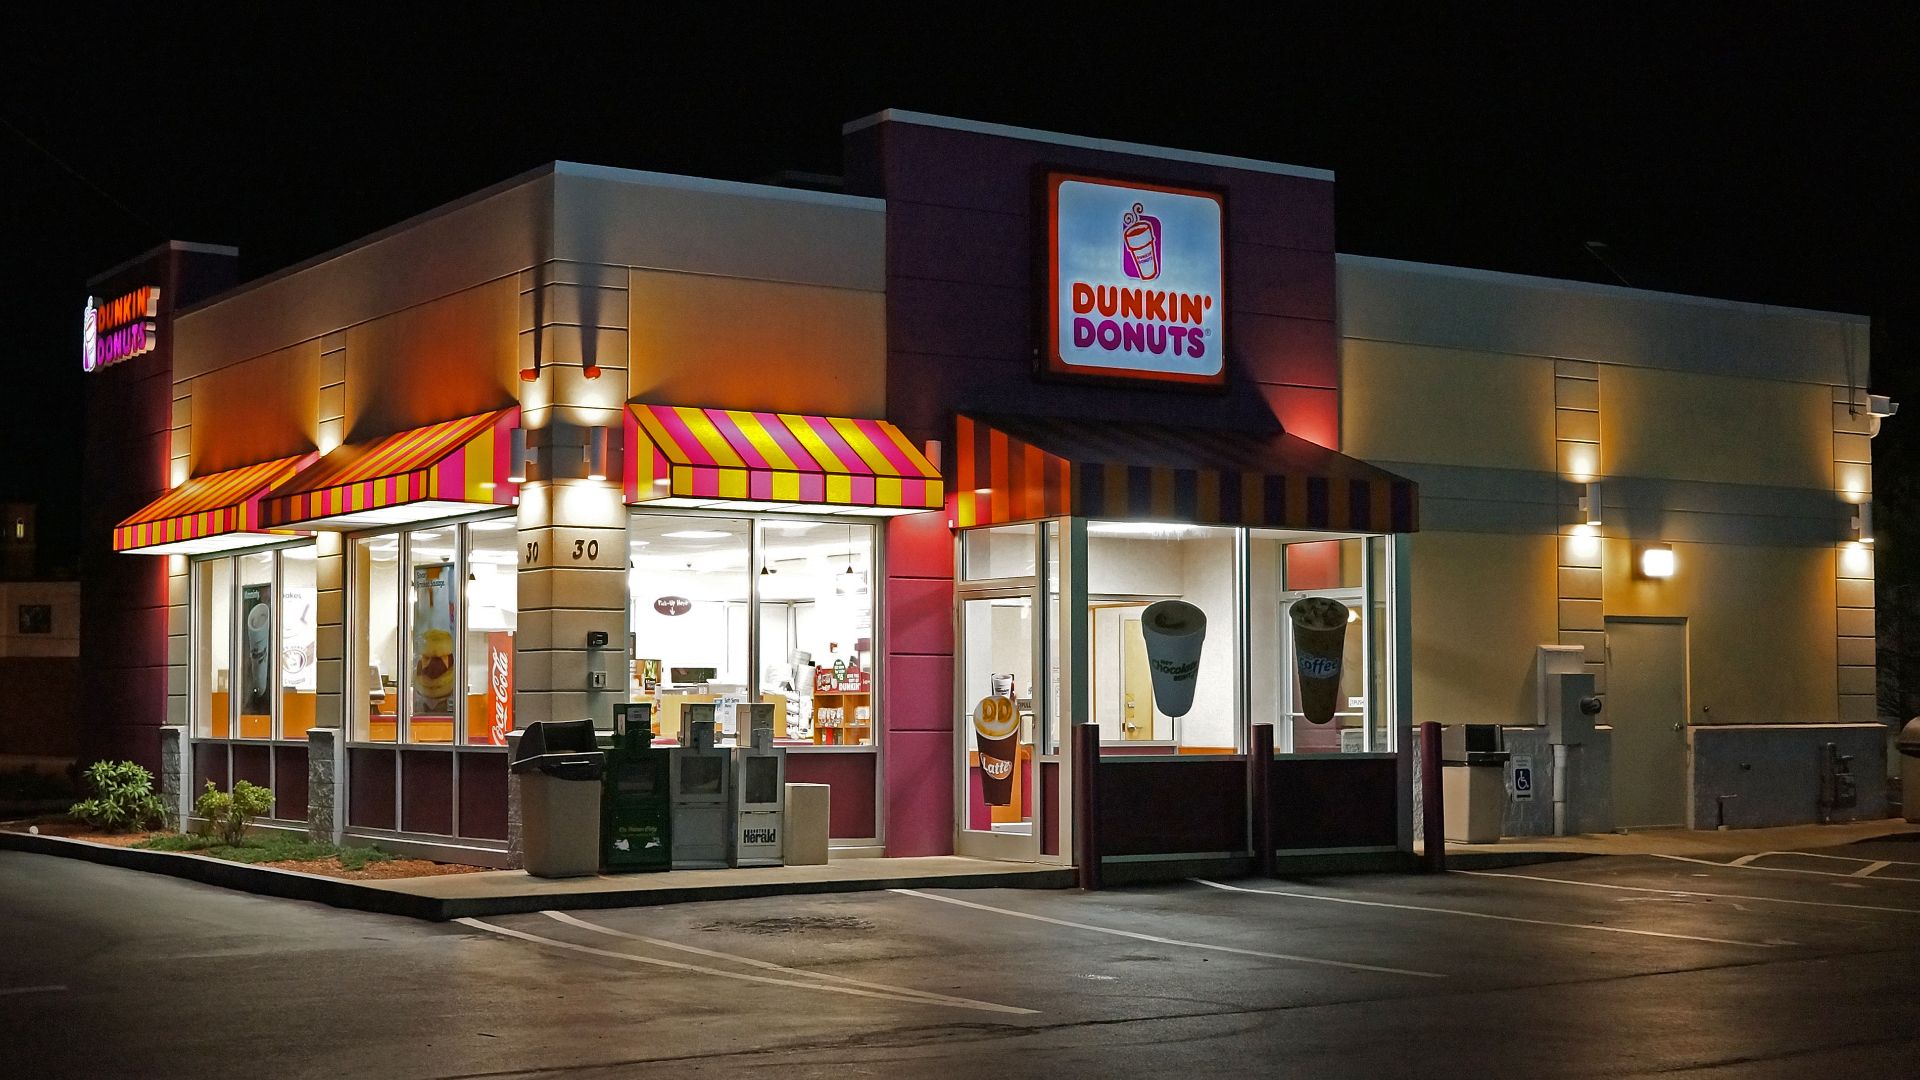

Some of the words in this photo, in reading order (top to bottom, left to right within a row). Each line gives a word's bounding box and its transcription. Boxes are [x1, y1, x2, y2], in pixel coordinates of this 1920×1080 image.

[97, 284, 151, 333] DUNKIN'
[1072, 282, 1212, 325] DUNKIN'
[96, 321, 146, 366] DONUTS
[1073, 317, 1206, 358] DONUTS
[526, 542, 539, 564] 30
[572, 539, 599, 560] 30
[982, 756, 1011, 774] Latte
[743, 829, 777, 843] Herald
